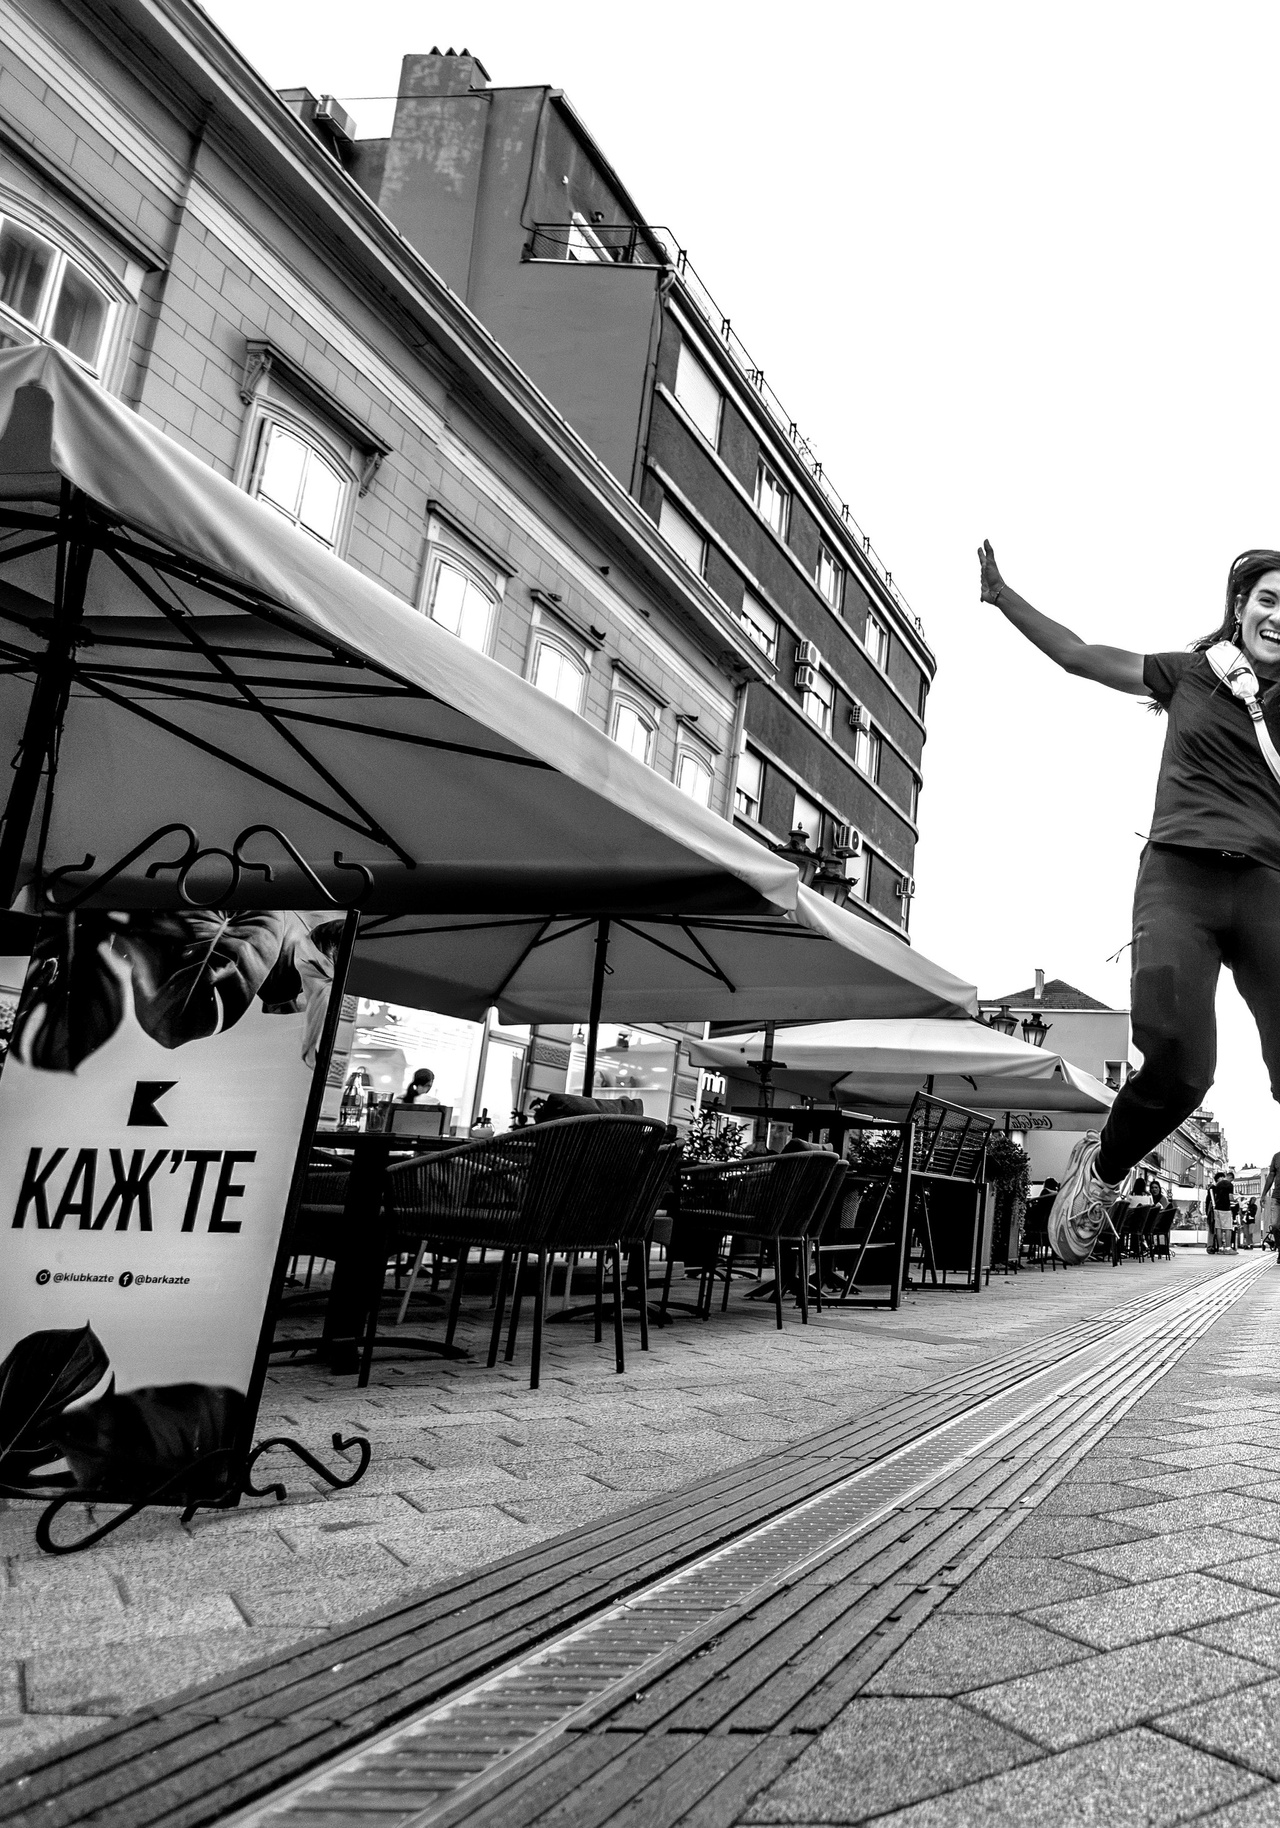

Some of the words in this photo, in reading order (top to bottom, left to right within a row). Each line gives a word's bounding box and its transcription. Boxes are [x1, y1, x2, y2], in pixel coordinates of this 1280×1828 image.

[11, 1147, 257, 1233] КАЖ'ТЕ
[53, 1272, 115, 1284] @klubkazte
[134, 1274, 191, 1286] @barkazte
